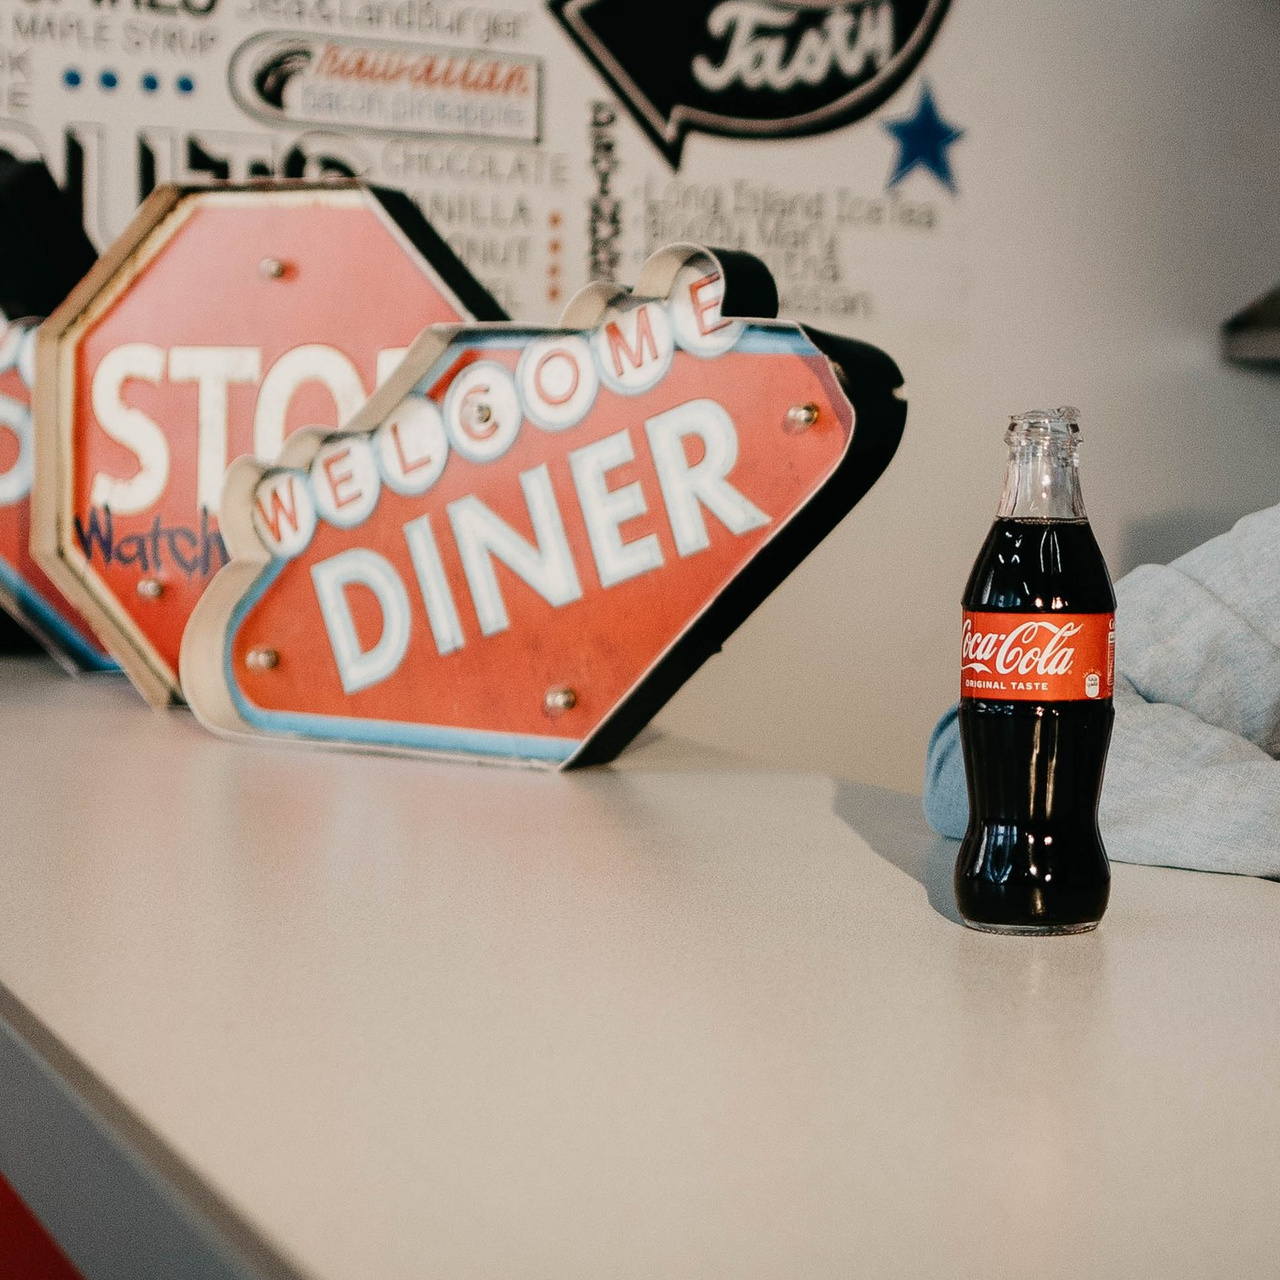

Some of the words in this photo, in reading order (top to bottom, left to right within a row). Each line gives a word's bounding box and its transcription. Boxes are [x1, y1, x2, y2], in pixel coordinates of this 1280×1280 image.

[91, 341, 411, 517] STO
[254, 271, 733, 546] WELCOME
[74, 499, 232, 581] Watch
[311, 397, 773, 696] DINER
[962, 618, 1084, 675] Coca-Cola
[965, 679, 1007, 690] ORIGINAL
[1010, 681, 1049, 691] TASTE
